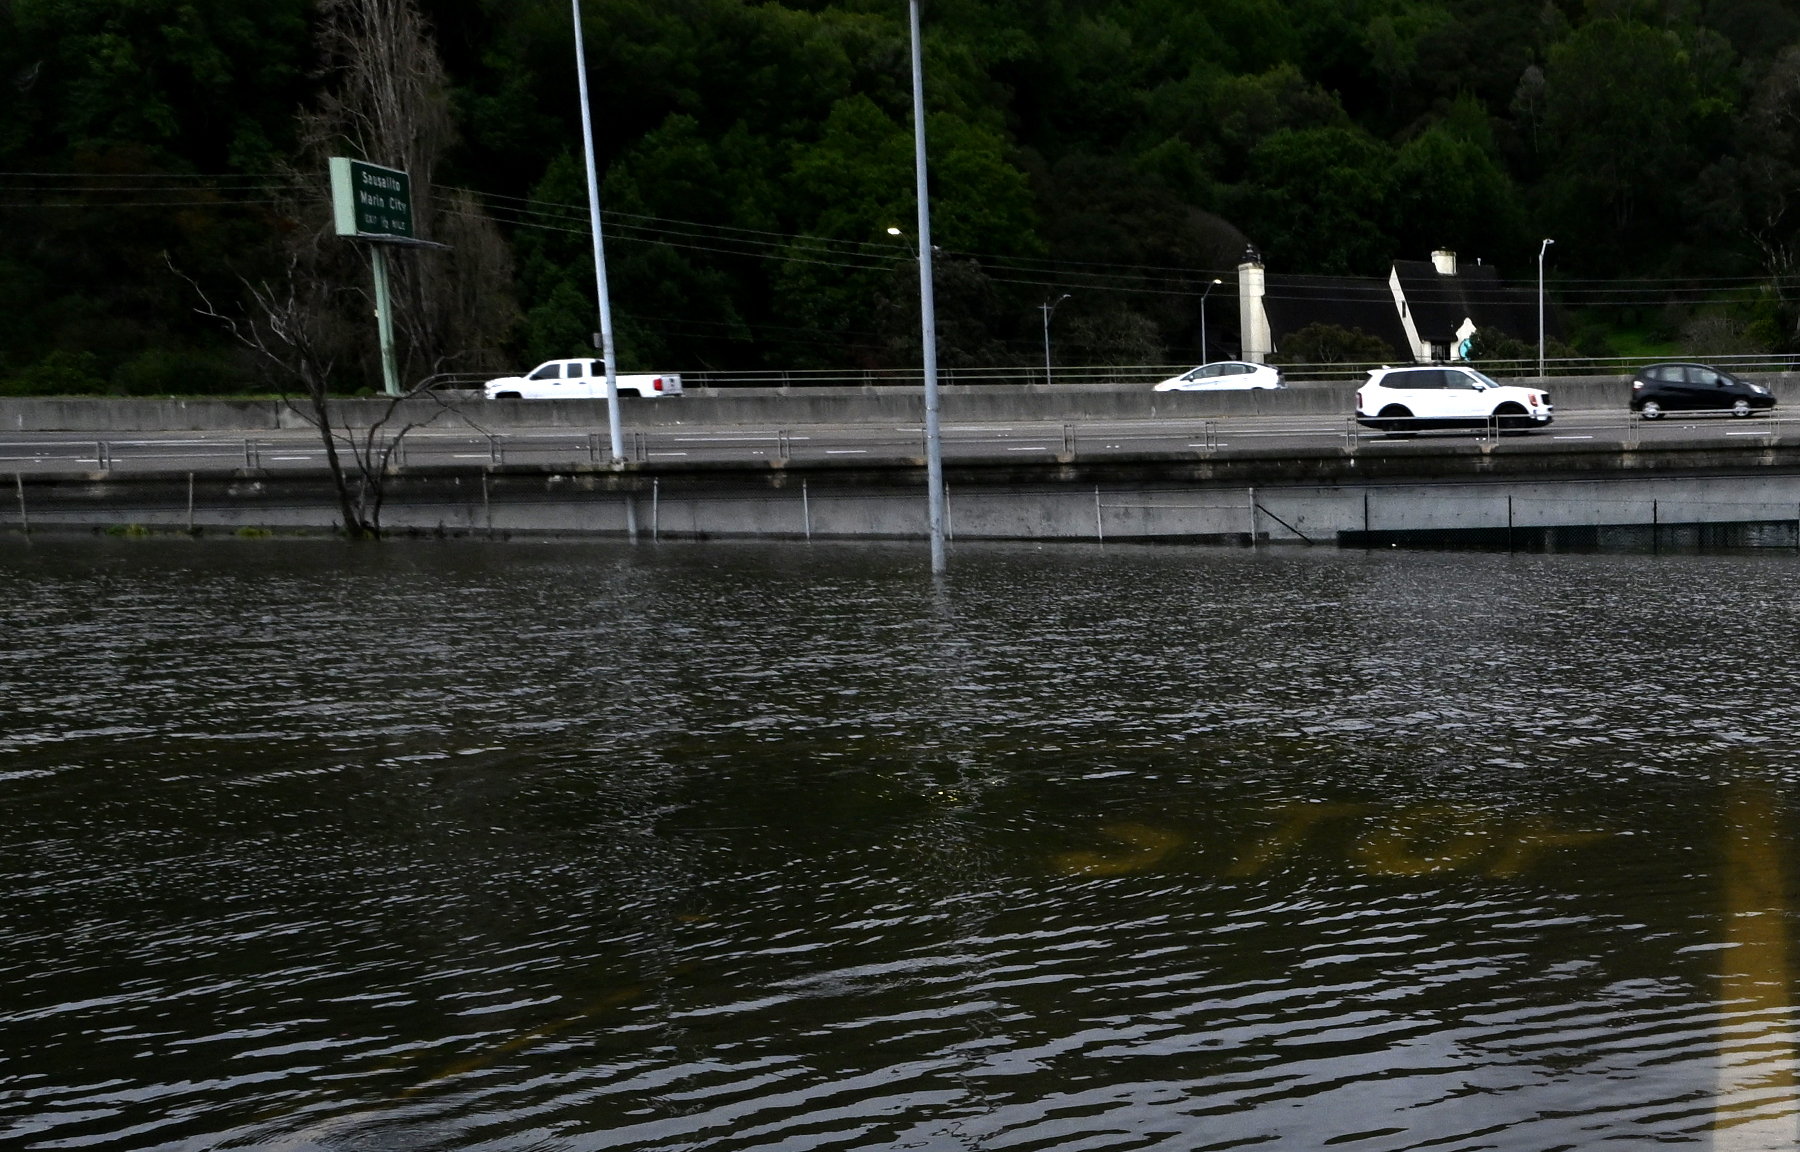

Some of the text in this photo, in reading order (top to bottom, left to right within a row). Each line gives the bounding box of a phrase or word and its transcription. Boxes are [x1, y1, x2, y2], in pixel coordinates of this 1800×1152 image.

[362, 171, 400, 191] Sausalito
[360, 190, 407, 214] Marin City
